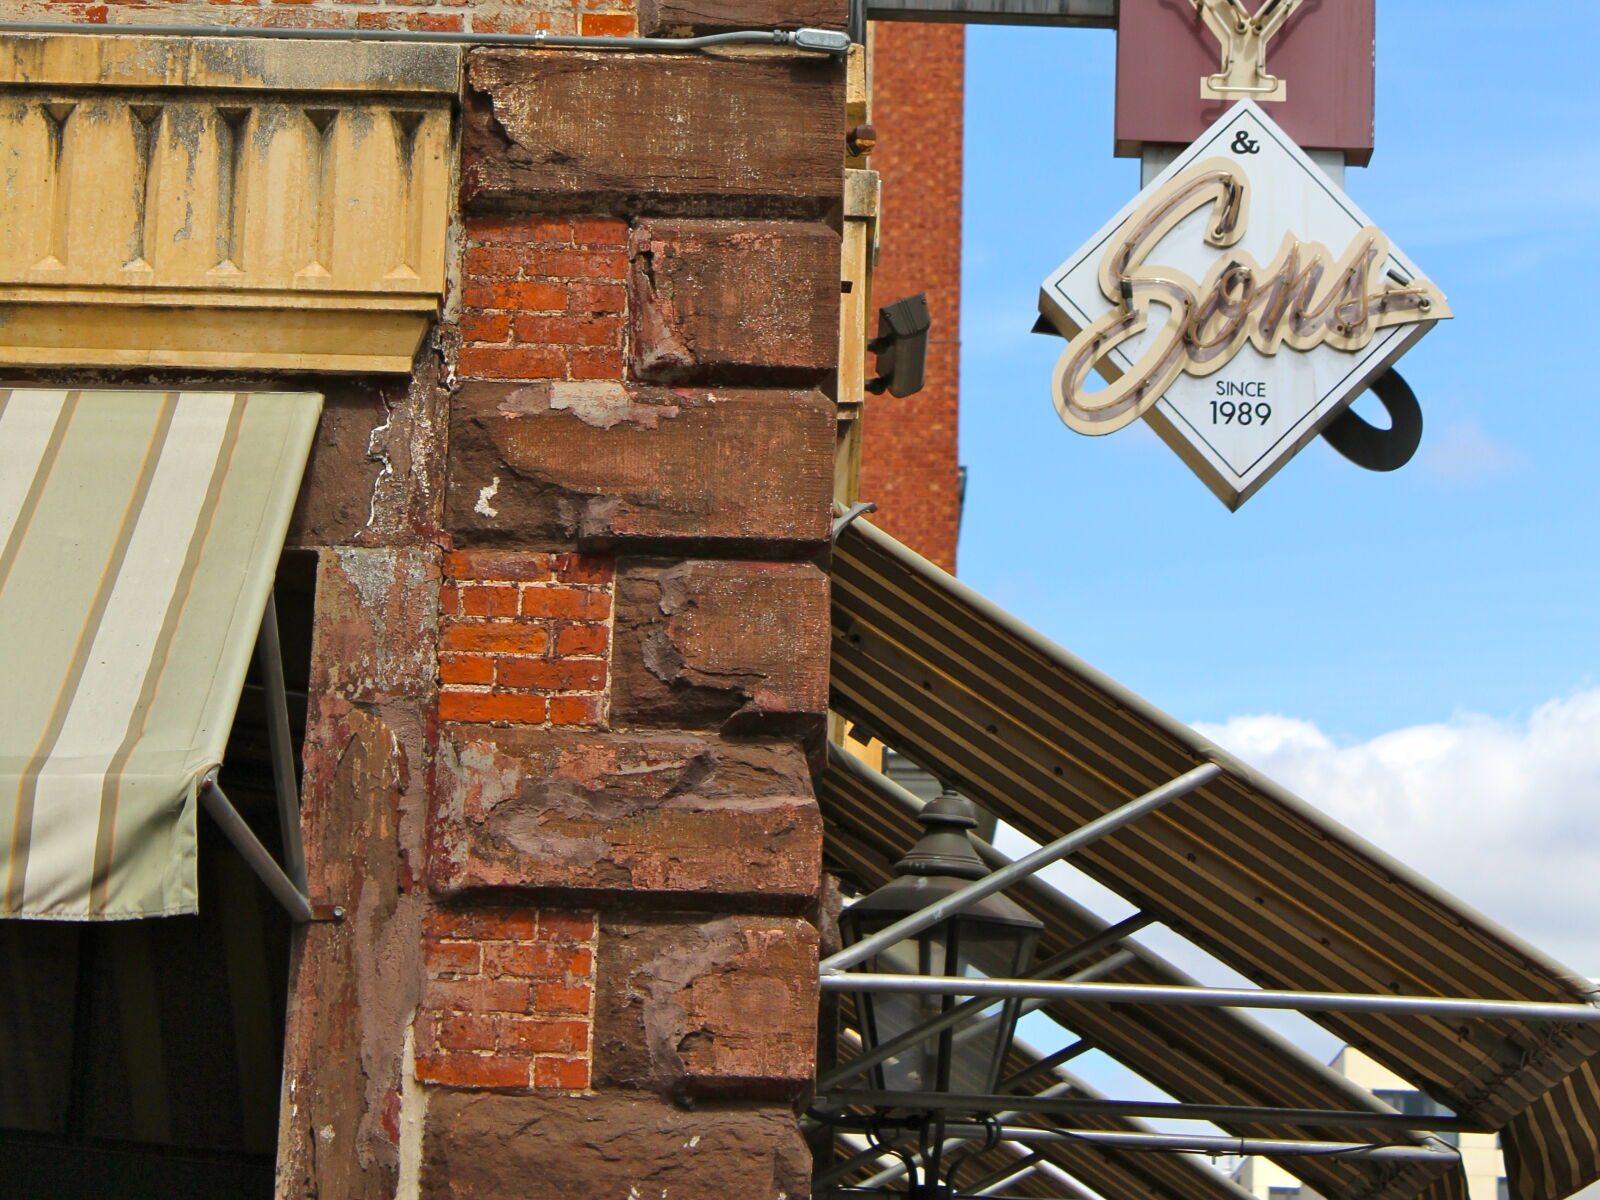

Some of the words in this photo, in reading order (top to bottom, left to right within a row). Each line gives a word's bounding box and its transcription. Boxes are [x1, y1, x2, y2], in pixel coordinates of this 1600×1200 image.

[1231, 131, 1260, 154] &
[1051, 156, 1455, 437] Sons
[1216, 380, 1266, 398] SINCE
[1210, 401, 1272, 426] 1989
